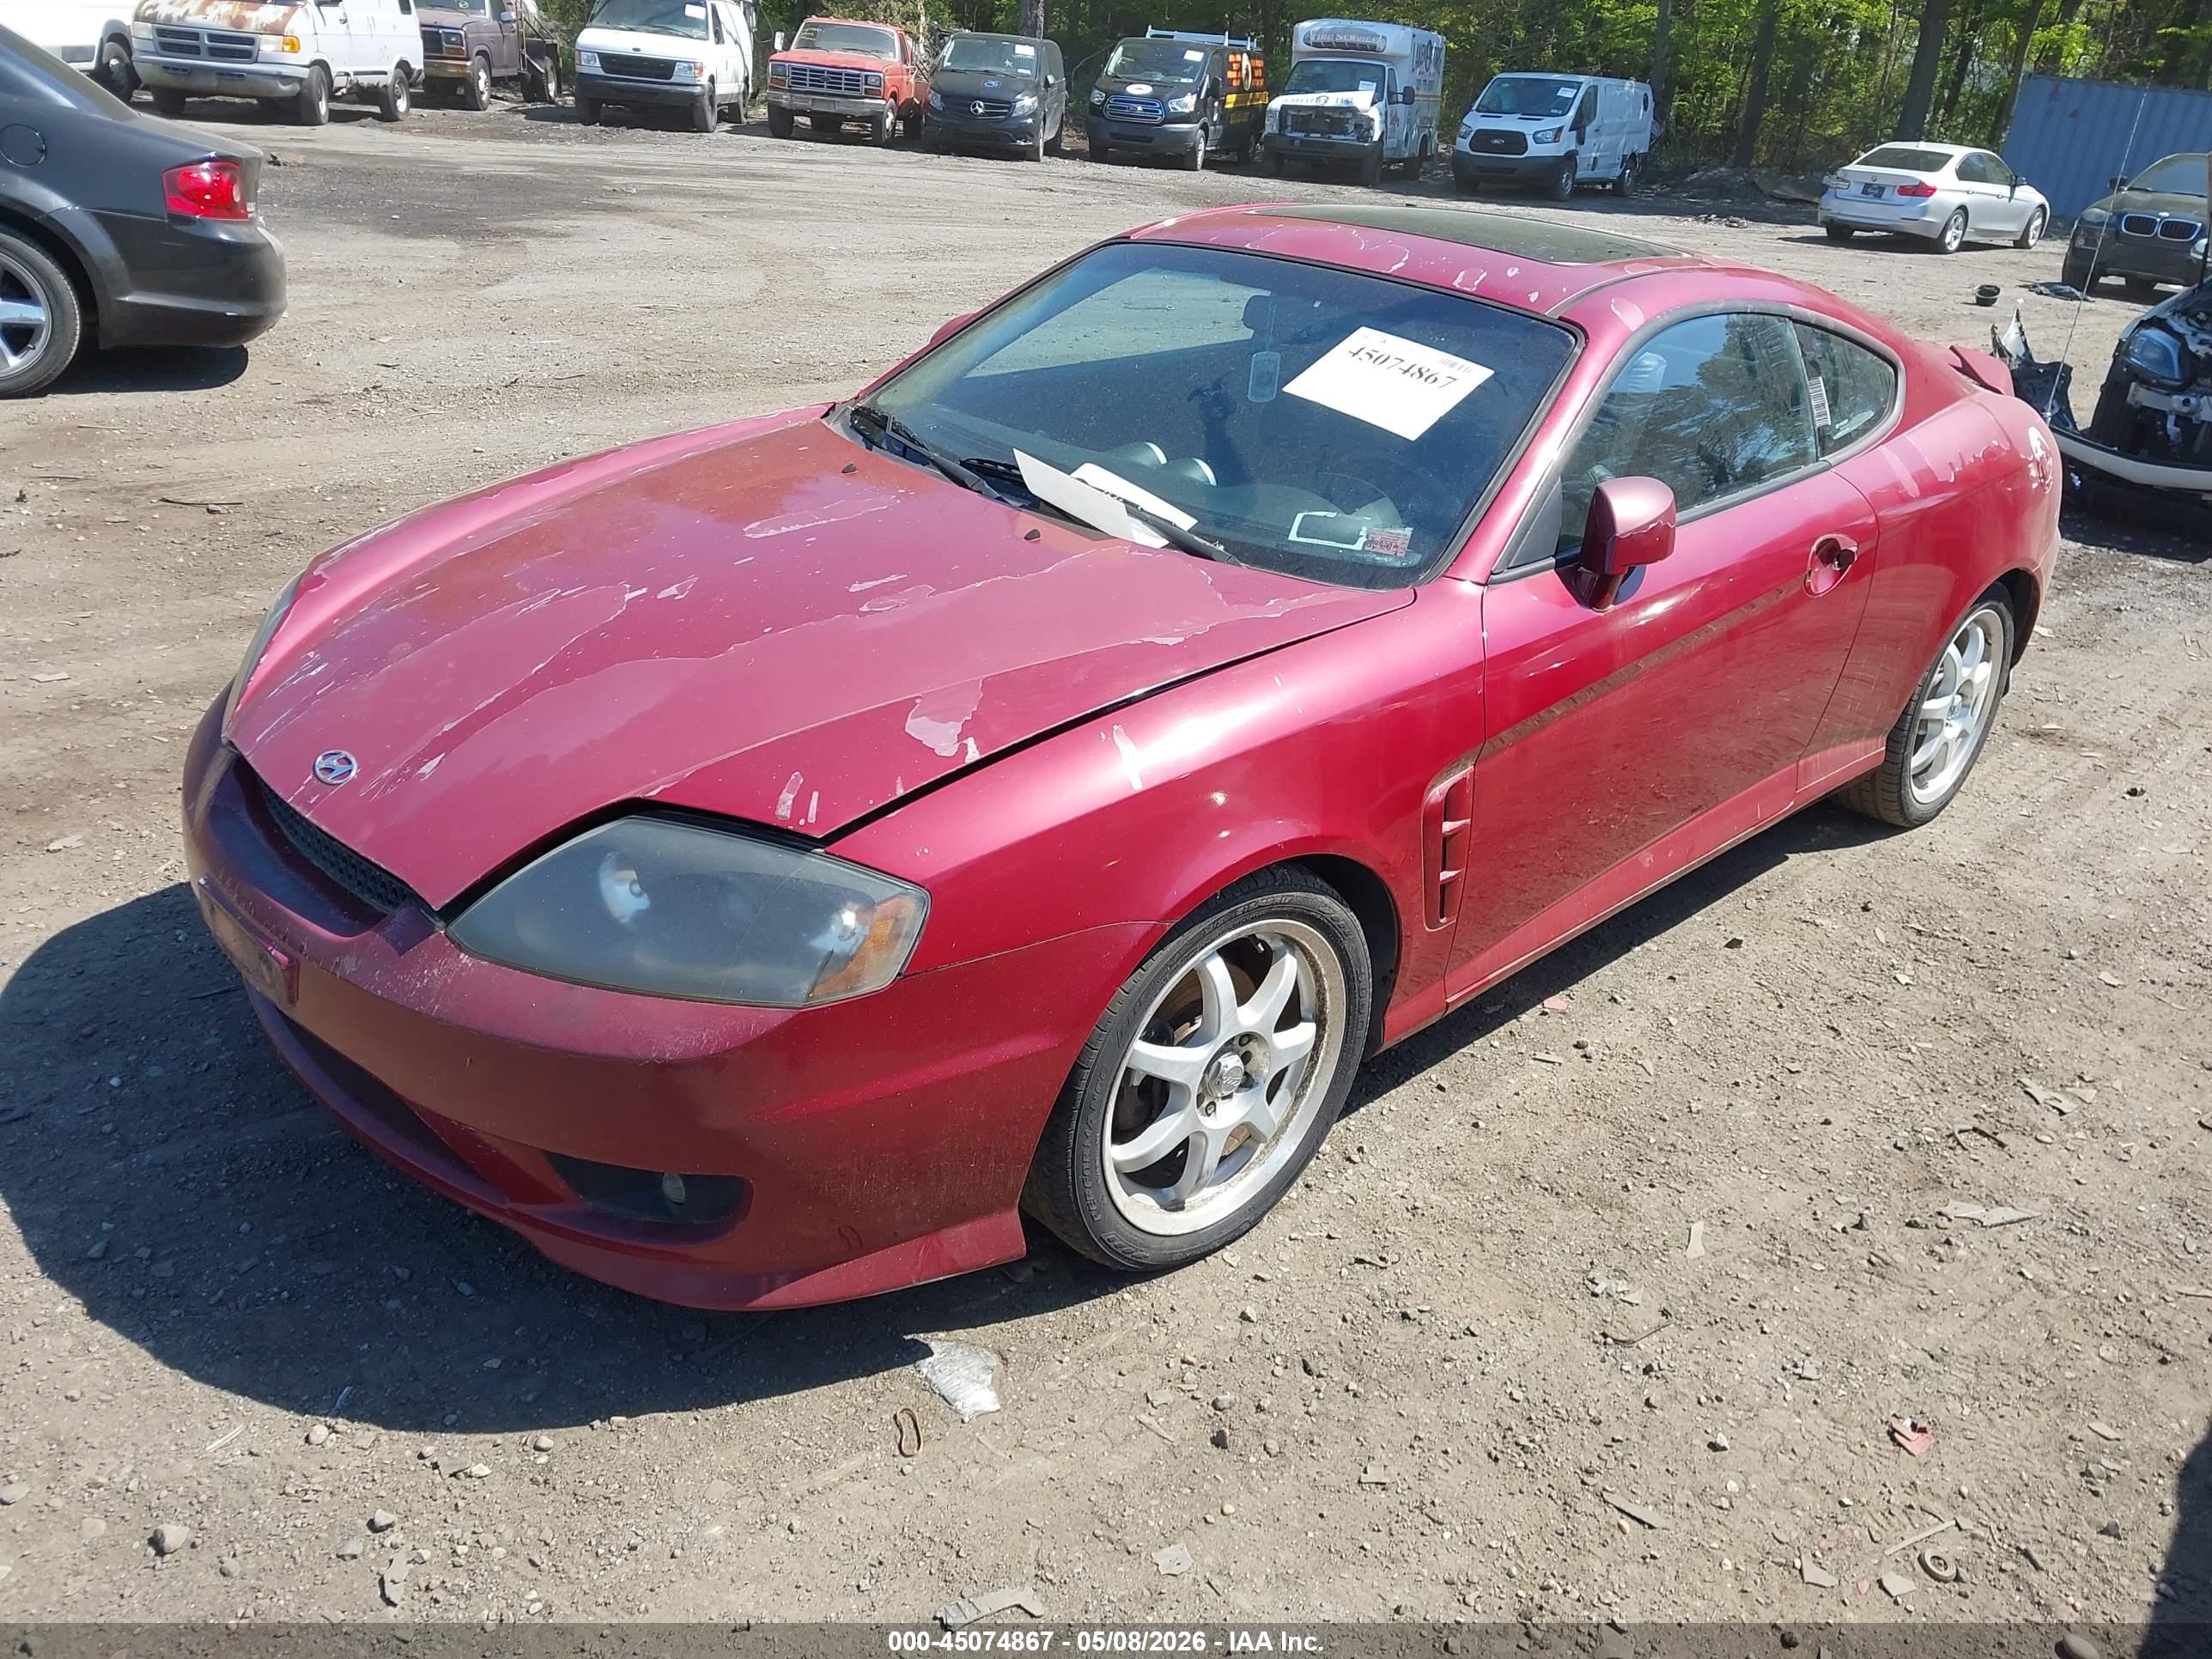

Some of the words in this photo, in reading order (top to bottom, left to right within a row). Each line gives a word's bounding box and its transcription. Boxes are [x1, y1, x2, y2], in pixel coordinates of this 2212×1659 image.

[1334, 33, 1380, 44] SERVICE
[1348, 345, 1458, 390] 45074867
[1081, 1067, 1109, 1223] PERFORMANCE
